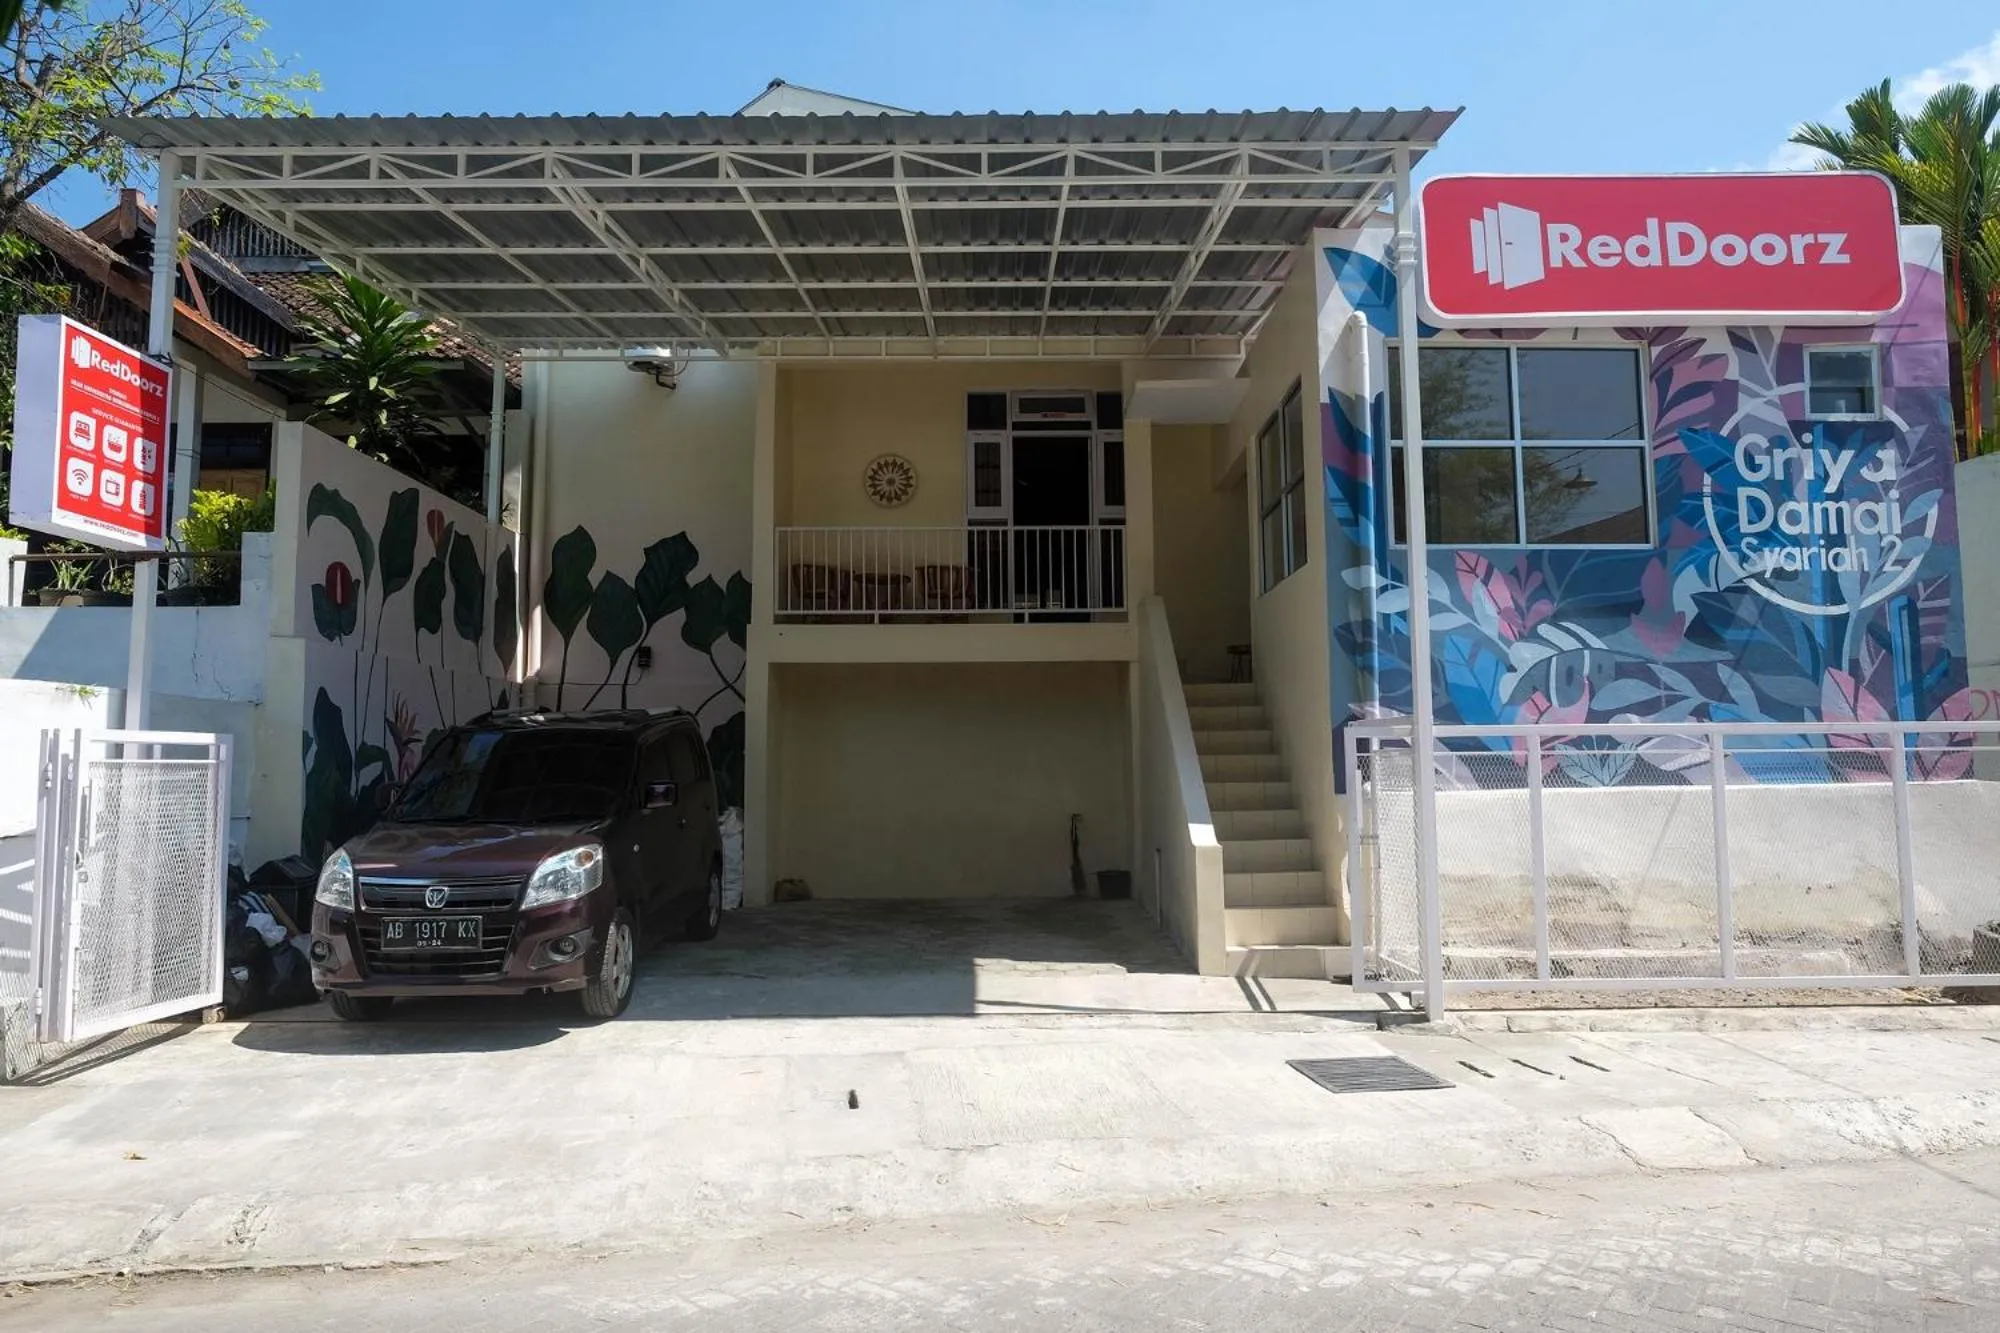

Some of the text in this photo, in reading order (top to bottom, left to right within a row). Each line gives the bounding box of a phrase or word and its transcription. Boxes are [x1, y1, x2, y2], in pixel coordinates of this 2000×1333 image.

[1546, 217, 1852, 269] RedDoorz
[91, 349, 163, 397] RedDoorz
[1734, 432, 1897, 494] Griya
[1737, 486, 1902, 536] Damai
[1740, 535, 1904, 578] Syariah 2
[387, 920, 476, 939] AB 1917 KX
